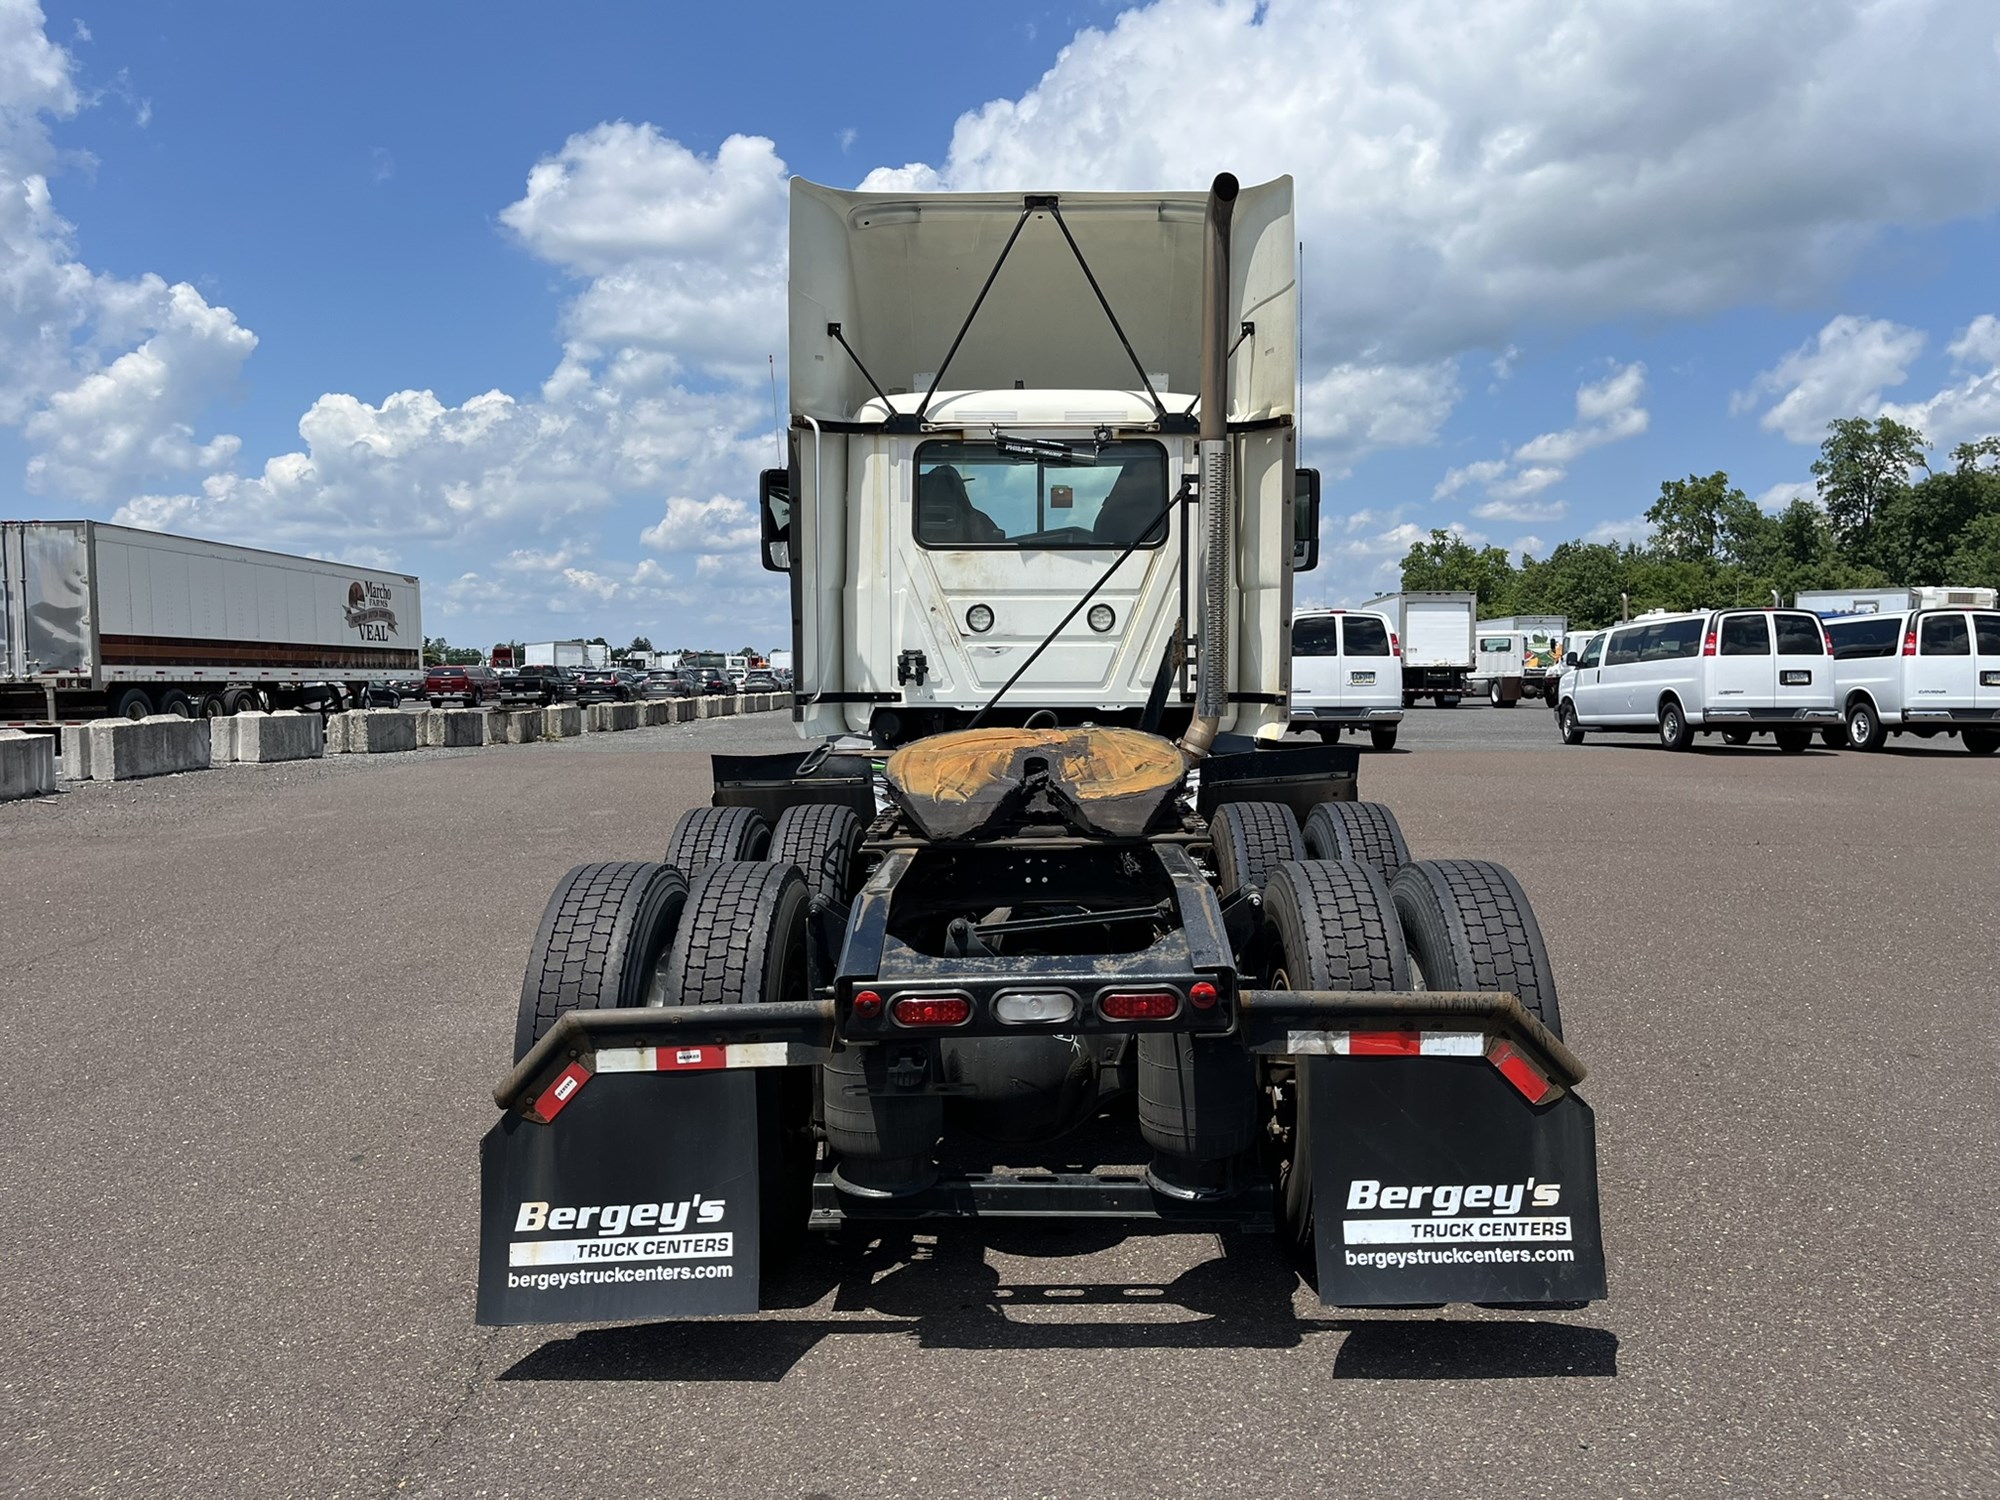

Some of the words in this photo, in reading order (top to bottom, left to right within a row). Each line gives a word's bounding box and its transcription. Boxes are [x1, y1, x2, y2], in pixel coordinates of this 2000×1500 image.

[1005, 444, 1034, 453] PHILIPS
[365, 581, 392, 600] Marcho
[369, 599, 389, 607] FARMS
[359, 624, 389, 642] VEAL
[1346, 1177, 1561, 1216] Bergey's
[514, 1193, 726, 1236] Bergey's
[1411, 1223, 1475, 1238] TRUCK
[1478, 1221, 1568, 1237] CENTERS
[577, 1242, 640, 1258] TRUCK
[642, 1238, 729, 1255] CENTERS
[1345, 1247, 1575, 1269] bergeystruckcenters.com
[508, 1264, 733, 1290] bergeystruckcenters.com
